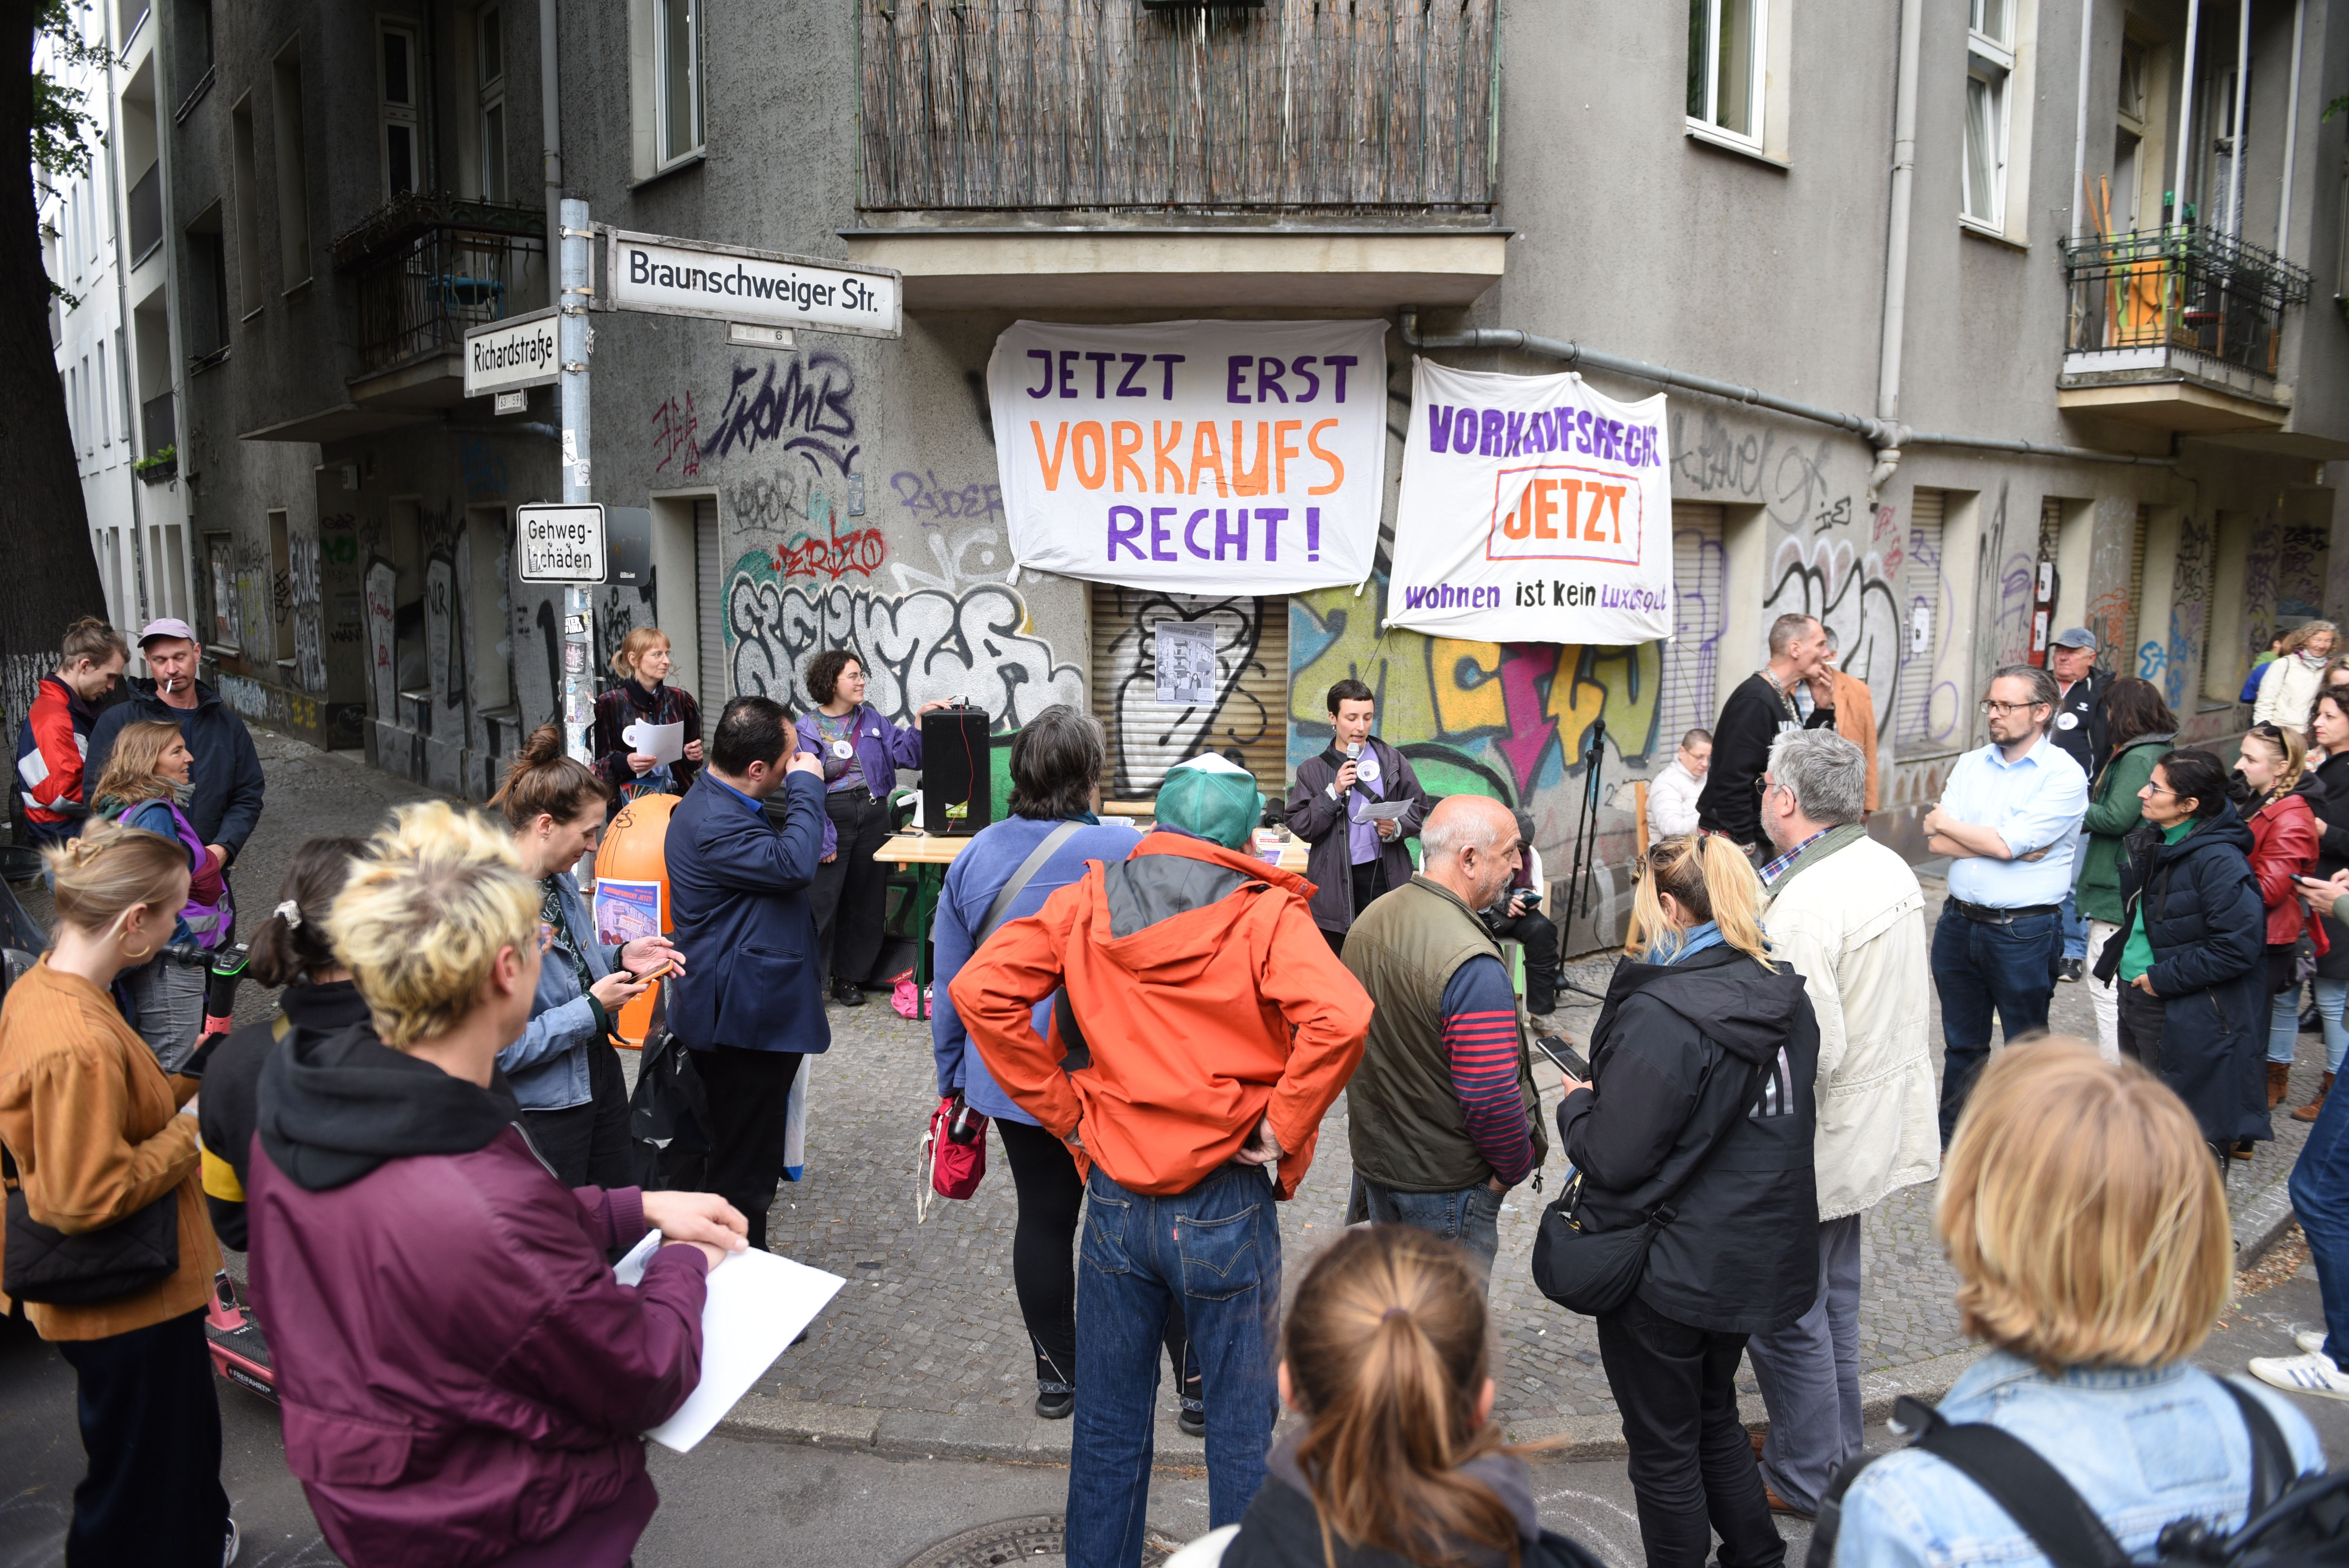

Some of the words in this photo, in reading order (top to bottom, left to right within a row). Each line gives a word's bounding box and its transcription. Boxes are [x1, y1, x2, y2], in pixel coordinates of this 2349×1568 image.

[630, 250, 836, 312] Braunschweiger
[842, 278, 879, 312] Str.
[474, 328, 553, 373] Richardstraße
[512, 395, 520, 406] 59
[1026, 349, 1185, 401] JETZT
[1227, 355, 1358, 404] ERST
[1029, 418, 1344, 498] VORKAUFS
[1429, 404, 1661, 467] VORKAUFSRECHT
[529, 519, 592, 545] Gehweg-
[1503, 478, 1626, 544] JETZT
[533, 549, 592, 569] chäden
[1516, 579, 1546, 606] ist
